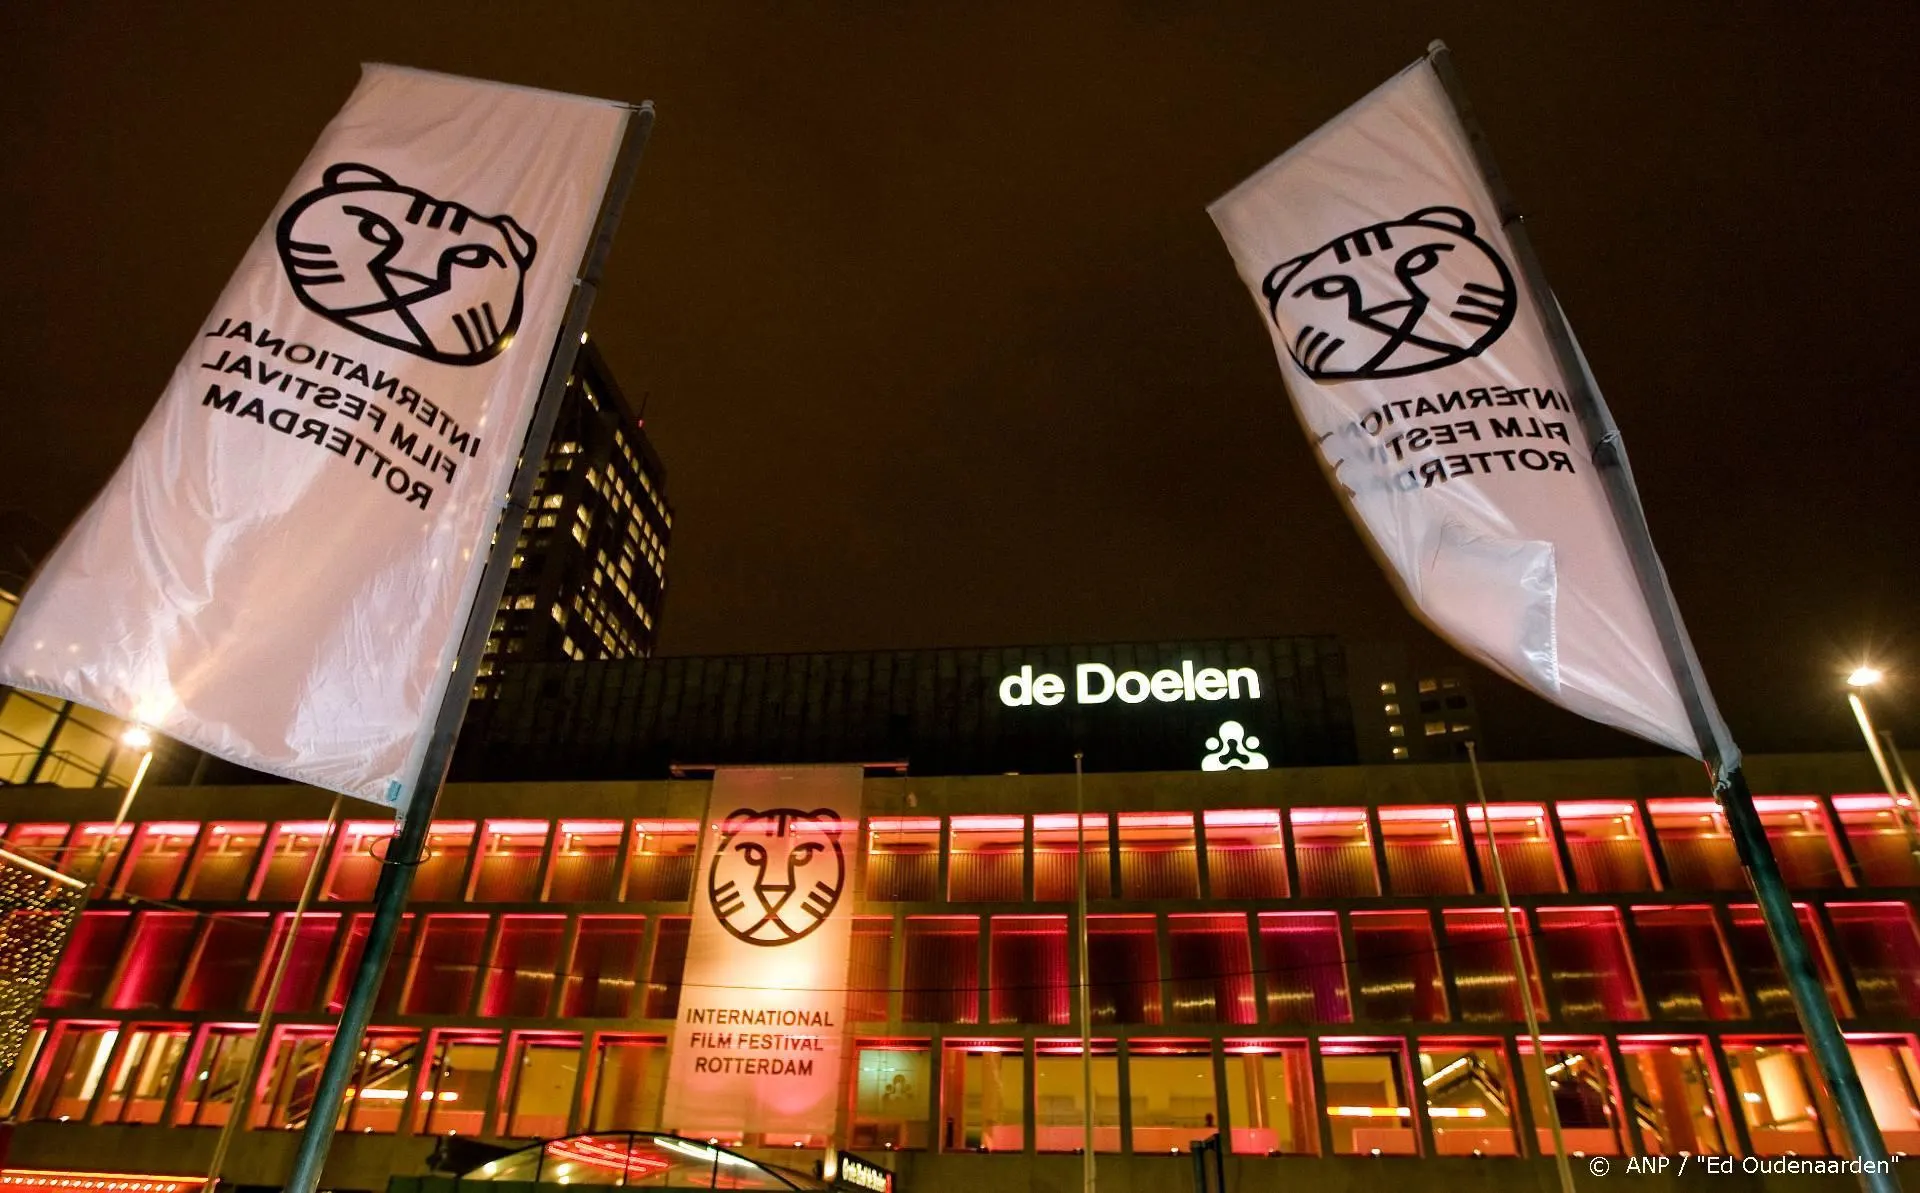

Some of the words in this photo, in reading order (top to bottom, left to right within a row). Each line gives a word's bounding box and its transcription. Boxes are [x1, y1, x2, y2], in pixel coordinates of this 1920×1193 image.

[999, 664, 1066, 706] de
[1076, 660, 1261, 704] Doelen
[686, 1008, 834, 1027] INTERNATIONAL
[690, 1032, 732, 1049] FILM
[737, 1033, 824, 1051] FESTIVAL
[694, 1057, 813, 1076] ROTTERDAM
